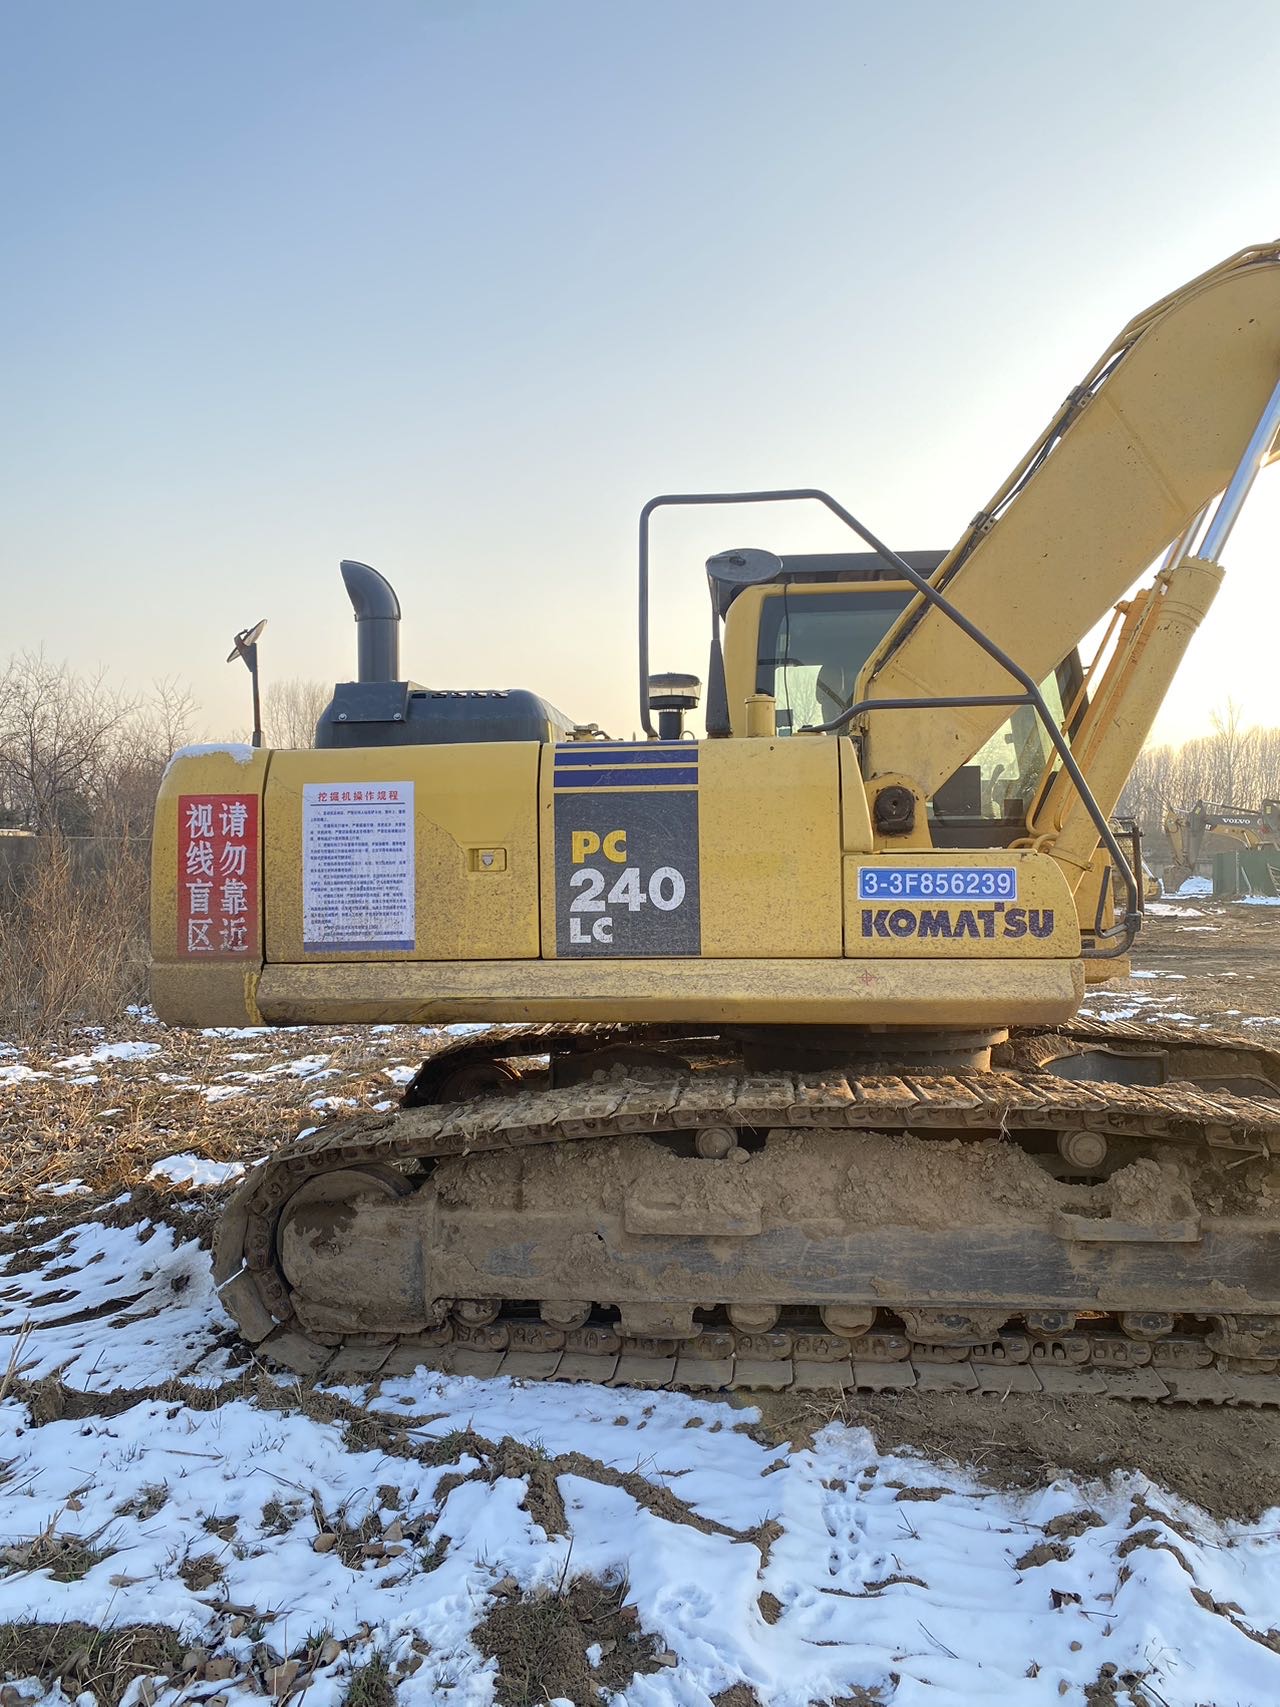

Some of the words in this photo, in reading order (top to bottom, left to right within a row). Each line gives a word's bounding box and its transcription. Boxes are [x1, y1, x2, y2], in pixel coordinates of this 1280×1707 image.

[318, 790, 399, 801] 挖掘机操作规程
[571, 829, 627, 864] PC
[185, 803, 215, 953] 视线盲区
[219, 802, 249, 952] 请勿靠近
[569, 866, 686, 912] 240
[864, 873, 1012, 894] 3-3F856239
[569, 916, 613, 944] LC
[861, 902, 1055, 938] KOMATSU
